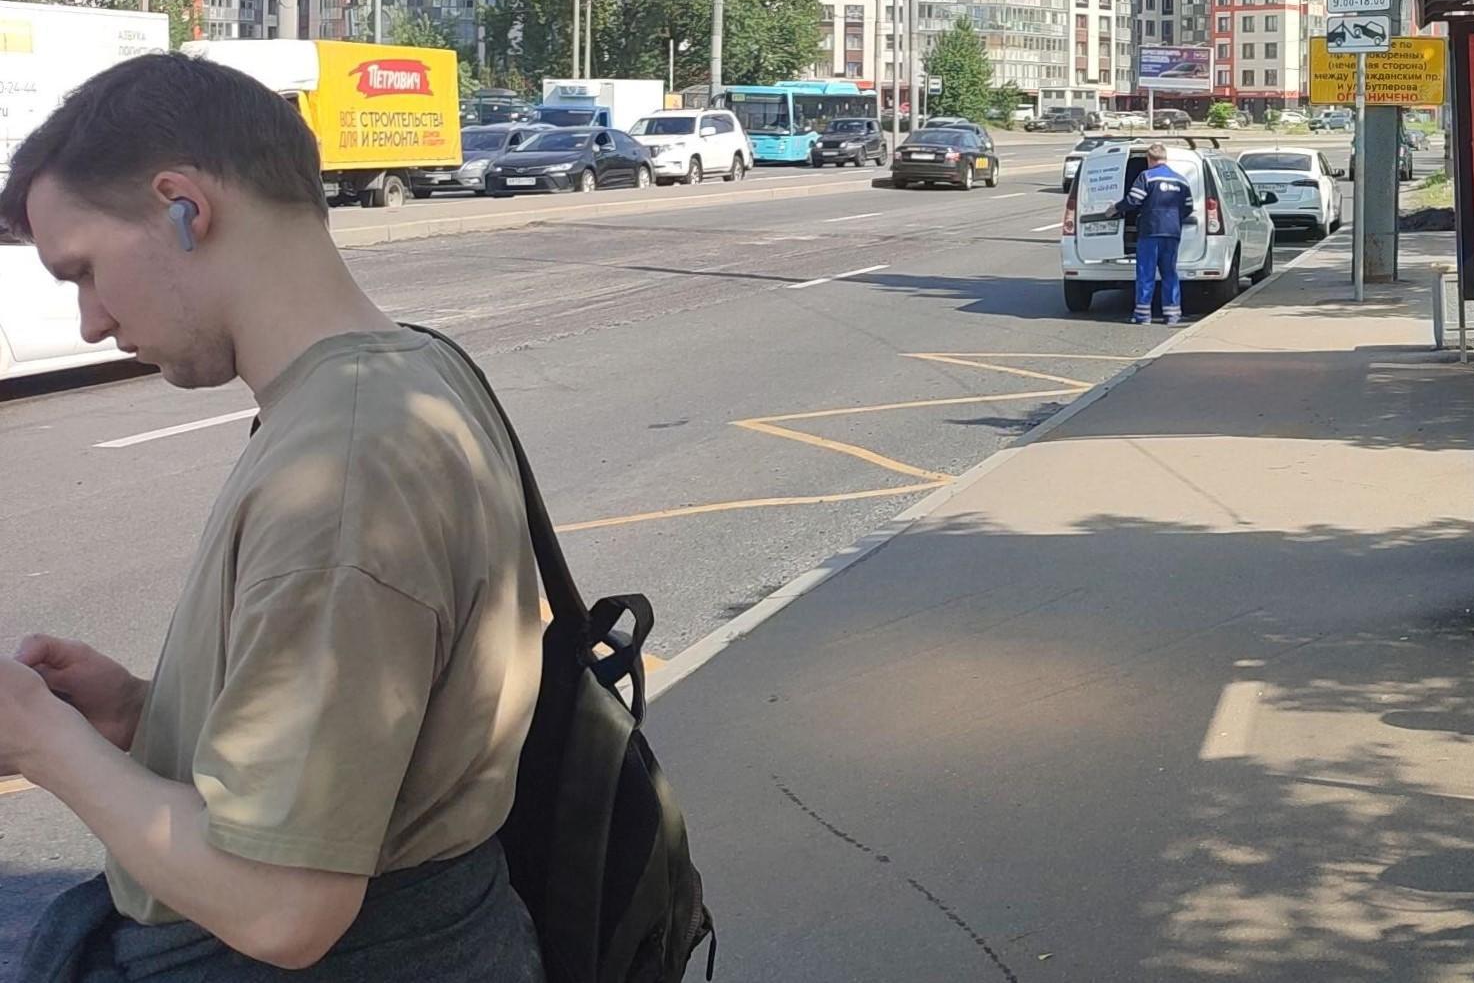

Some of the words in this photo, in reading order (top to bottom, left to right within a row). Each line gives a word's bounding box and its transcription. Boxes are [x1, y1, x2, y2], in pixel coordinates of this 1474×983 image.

[1328, 61, 1379, 71] (нечеая
[1382, 61, 1428, 71] сторона)
[1314, 72, 1349, 81] между
[1352, 72, 1422, 82] Гажданским
[1365, 82, 1418, 92] Бутлерова
[1337, 92, 1418, 102] ОГНИЧЕНО
[360, 111, 443, 128] СТРОИТЕЛЬСТВА
[361, 131, 369, 147] И
[372, 131, 419, 148] РЕМОНТА
